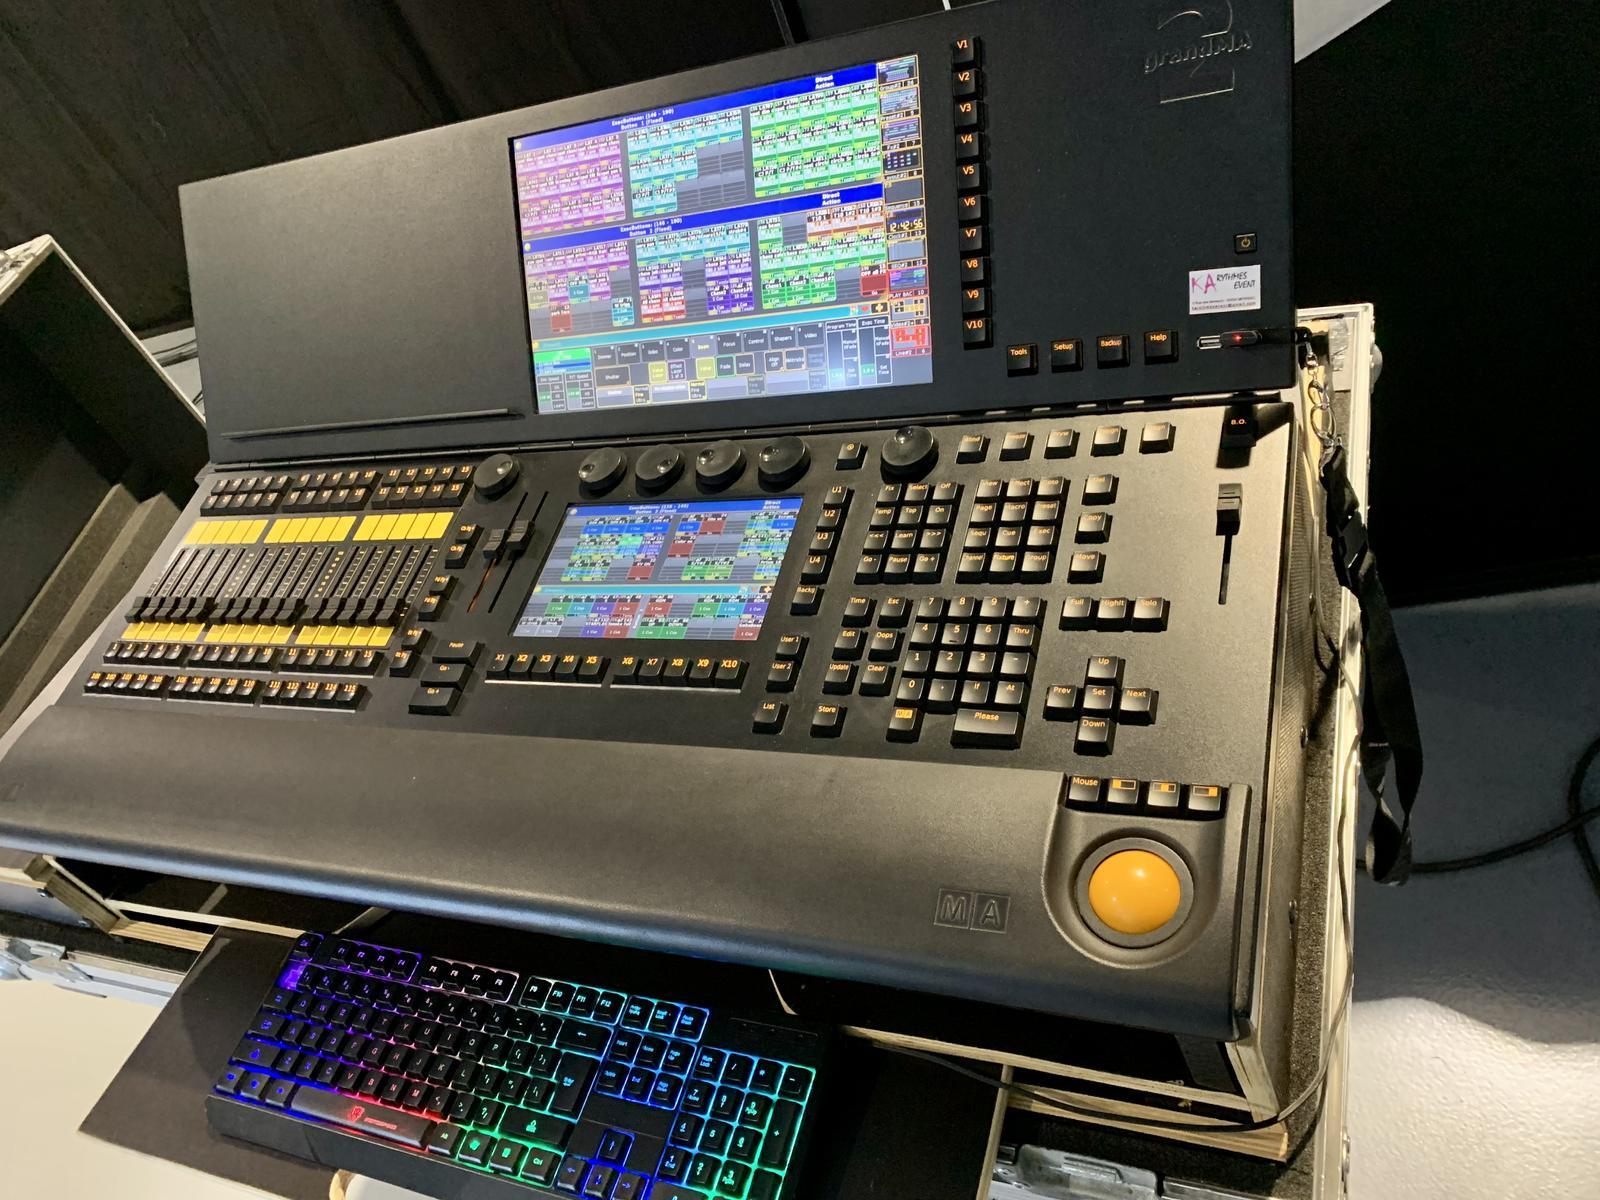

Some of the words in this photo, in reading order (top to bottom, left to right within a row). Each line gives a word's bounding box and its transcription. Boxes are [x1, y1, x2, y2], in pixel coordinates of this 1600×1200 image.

[956, 39, 969, 49] V1
[815, 75, 834, 83] Direct
[958, 71, 970, 81] V2
[815, 82, 835, 90] Action
[959, 102, 972, 113] V3
[960, 134, 973, 144] V4
[962, 165, 975, 175] V5
[822, 192, 840, 200] Direct
[822, 198, 841, 206] Action
[963, 197, 976, 206] V6
[965, 228, 977, 238] V7
[966, 259, 978, 269] V8
[1216, 271, 1248, 282] RYTHMES
[1233, 279, 1256, 290] EVENT
[967, 289, 979, 299] V9
[966, 319, 983, 330] V10
[1150, 333, 1168, 343] Help
[1053, 342, 1074, 352] Setup
[1100, 338, 1122, 348] Backup
[1010, 347, 1028, 357] Tools
[809, 556, 820, 564] U4
[887, 597, 899, 605] Esc
[929, 597, 934, 605] 7
[959, 597, 966, 605] 8
[991, 597, 998, 605] 9
[922, 623, 929, 631] 4
[954, 625, 960, 633] 5
[985, 625, 992, 633] 6
[1013, 626, 1030, 635] Thru
[780, 635, 794, 643] User
[876, 631, 894, 640] Oops
[289, 648, 297, 656] 11
[325, 649, 334, 657] 13
[363, 650, 372, 658] 15
[495, 653, 504, 662] X1
[517, 654, 528, 662] X2
[540, 654, 551, 663] X3
[562, 655, 574, 663] X4
[586, 656, 597, 664] X5
[621, 657, 633, 665] X6
[646, 657, 658, 665] X7
[914, 653, 920, 661] 1
[946, 653, 953, 661] 2
[979, 653, 986, 661] 3
[1098, 657, 1110, 665] Up
[671, 658, 683, 667] X8
[697, 659, 709, 667] X9
[720, 659, 738, 669] X10
[829, 664, 849, 672] Update
[867, 664, 885, 672] Clear
[90, 672, 101, 680] 101
[137, 673, 148, 681] 104
[192, 677, 203, 685] 107
[243, 680, 256, 688] 110
[269, 681, 281, 689] 111
[908, 680, 916, 689] 0
[287, 682, 299, 690] 112
[306, 682, 319, 690] 113
[325, 683, 337, 691] 114
[1053, 686, 1072, 694] Prev
[1092, 688, 1106, 696] Set
[763, 702, 775, 710] List
[818, 705, 836, 713] Store
[974, 712, 1000, 721] Please
[1082, 719, 1105, 727] Down
[1072, 777, 1098, 785] Mouse
[940, 893, 1001, 926] MA
[429, 965, 438, 973] F5
[494, 978, 503, 986] F8
[529, 985, 539, 993] F9
[552, 990, 563, 998] F10
[576, 995, 586, 1003] F11
[600, 999, 612, 1008] F12
